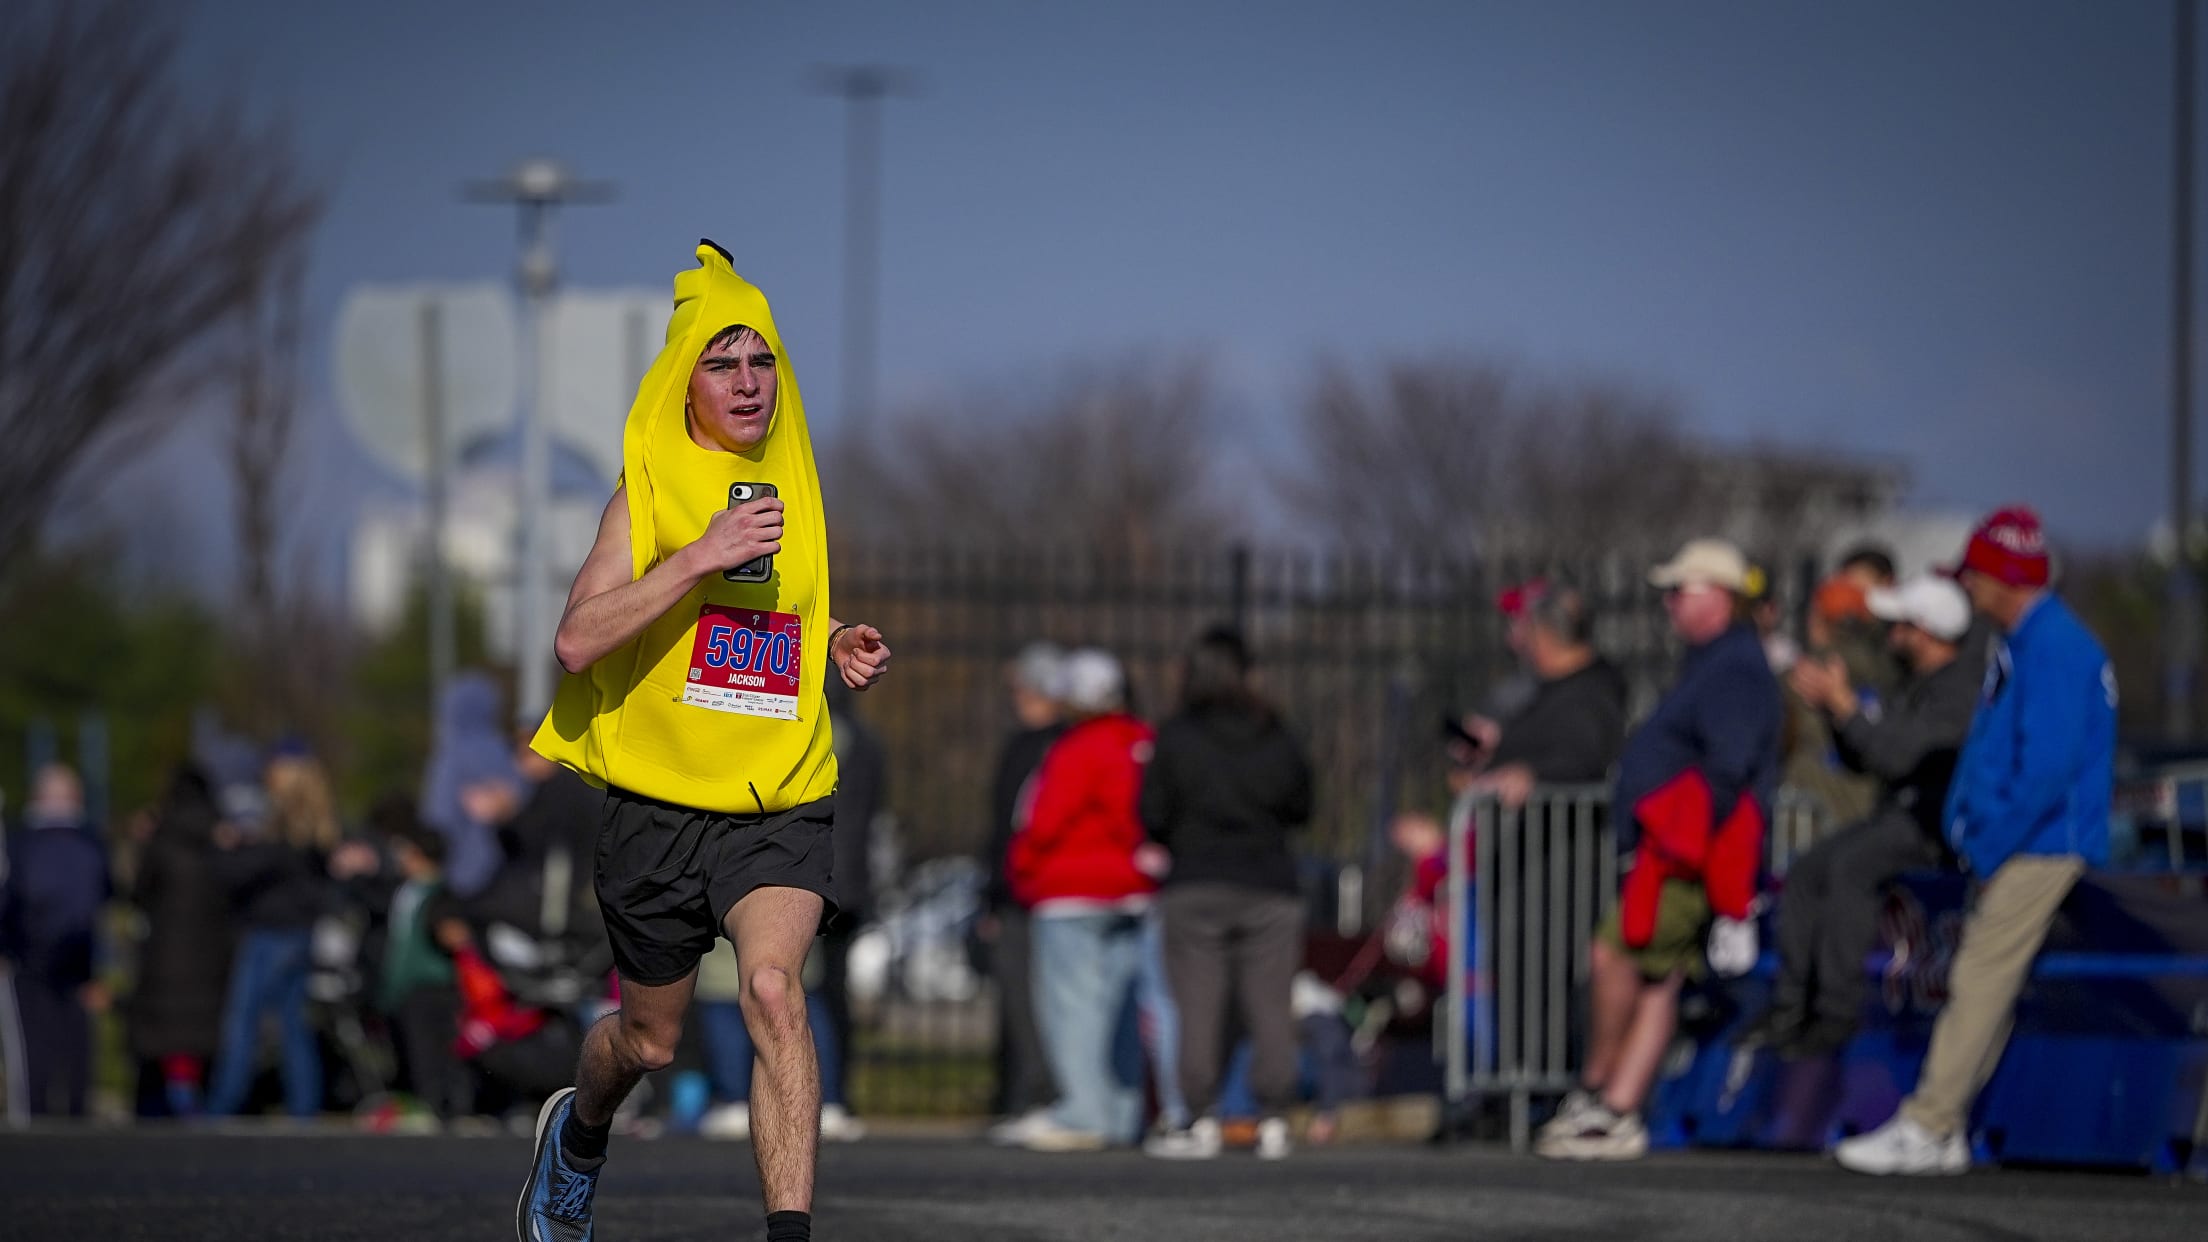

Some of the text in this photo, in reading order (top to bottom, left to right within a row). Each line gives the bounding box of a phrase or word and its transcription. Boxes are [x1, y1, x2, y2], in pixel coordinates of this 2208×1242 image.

[752, 614, 760, 626] P
[705, 624, 791, 675] 5970
[727, 672, 766, 688] JACKSON
